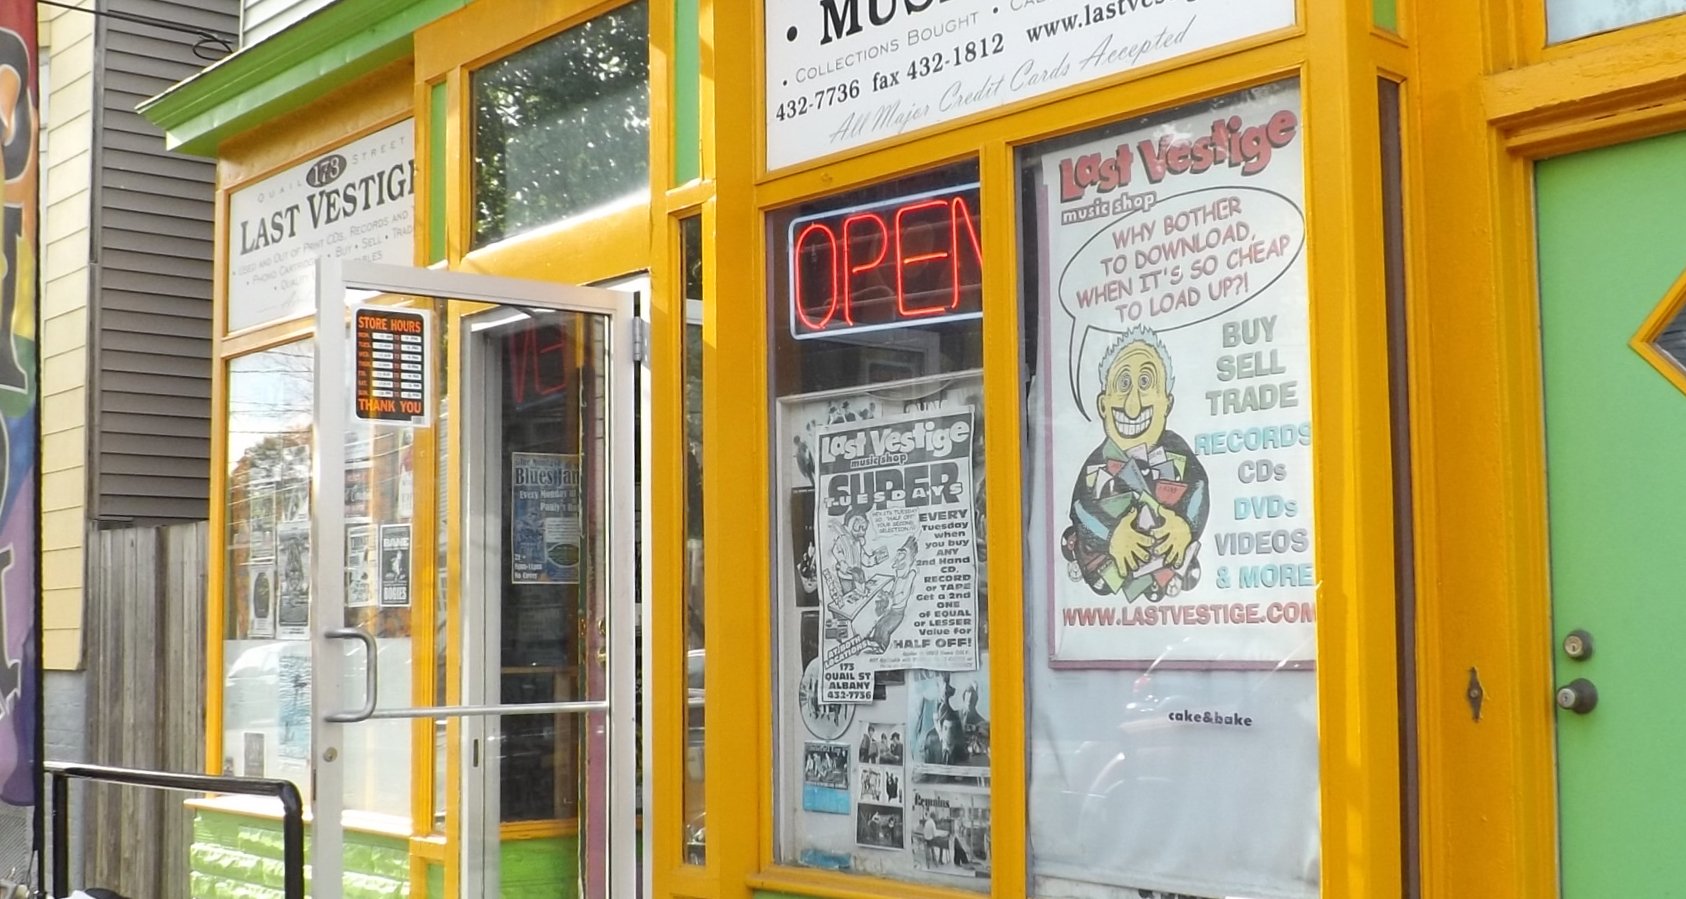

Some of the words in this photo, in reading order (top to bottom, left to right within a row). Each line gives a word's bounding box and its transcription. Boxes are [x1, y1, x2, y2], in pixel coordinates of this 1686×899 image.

[795, 39, 899, 83] COLLECTIONS
[907, 11, 979, 46] BOUGHT
[776, 79, 860, 122] 432-7736
[872, 71, 900, 93] fax
[907, 33, 1005, 81] 432-1812
[829, 112, 865, 144] All
[871, 99, 930, 134] Major
[938, 75, 1005, 112] Credit
[1010, 52, 1071, 91] Cards
[1079, 14, 1197, 70] Accepted
[1059, 143, 1133, 203] Last
[1137, 110, 1297, 184] Vestige
[257, 180, 302, 203] QUAIL
[312, 157, 341, 186] 173
[352, 136, 406, 165] STREET
[1061, 200, 1110, 225] music
[1112, 191, 1157, 215] shop
[240, 204, 300, 256] LAST
[392, 225, 413, 240] TRAD
[1112, 220, 1157, 250] WHY
[1164, 196, 1242, 235] BOTHER
[1100, 254, 1127, 277] TO
[1134, 221, 1256, 270] DOWNLOAD,
[1076, 278, 1133, 309] WHEN
[1140, 267, 1184, 294] IT'S
[1190, 255, 1218, 280] SO
[1226, 234, 1291, 269] CHEAP
[1115, 302, 1142, 323] TO
[1150, 287, 1201, 317] LOAD
[1208, 273, 1249, 301] UP?!
[358, 316, 388, 330] STORE
[391, 320, 421, 333] HOURS
[1222, 315, 1277, 348] BUY
[1215, 350, 1286, 382] SELL
[358, 398, 396, 412] THANK
[400, 400, 421, 413] YOU
[1206, 381, 1298, 415] TRADE
[821, 432, 866, 464] Last
[870, 421, 970, 457] Vestige
[1194, 421, 1311, 457] RECORDS
[851, 456, 878, 468] music
[880, 452, 909, 465] shop
[1238, 459, 1287, 483] CDs
[515, 468, 553, 485] Blues
[827, 461, 960, 516] SUPER
[919, 509, 968, 522] EVERY
[1234, 495, 1298, 520] DVDs
[922, 522, 968, 531] Tuesday
[934, 531, 965, 539] when
[925, 541, 945, 550] you
[948, 539, 969, 547] buy
[937, 548, 959, 556] ANY
[1214, 528, 1309, 556] VIDEOS
[916, 558, 935, 566] 2nd
[939, 556, 970, 564] Hand
[924, 574, 971, 583] RECORD
[1216, 564, 1231, 588] &
[1238, 563, 1313, 588] MORE
[916, 593, 934, 601] Get
[929, 618, 971, 626] LESSER
[1062, 602, 1316, 627] WWW.LASTVESTIGE.COM
[893, 639, 931, 648] HALF
[935, 638, 972, 648] OFF!
[825, 672, 855, 681] QUAIL
[859, 672, 872, 680] ST
[840, 663, 854, 671] 173
[827, 691, 872, 700] 432-7736
[829, 682, 870, 690] ALBANY
[1168, 709, 1253, 726] cake&bake
